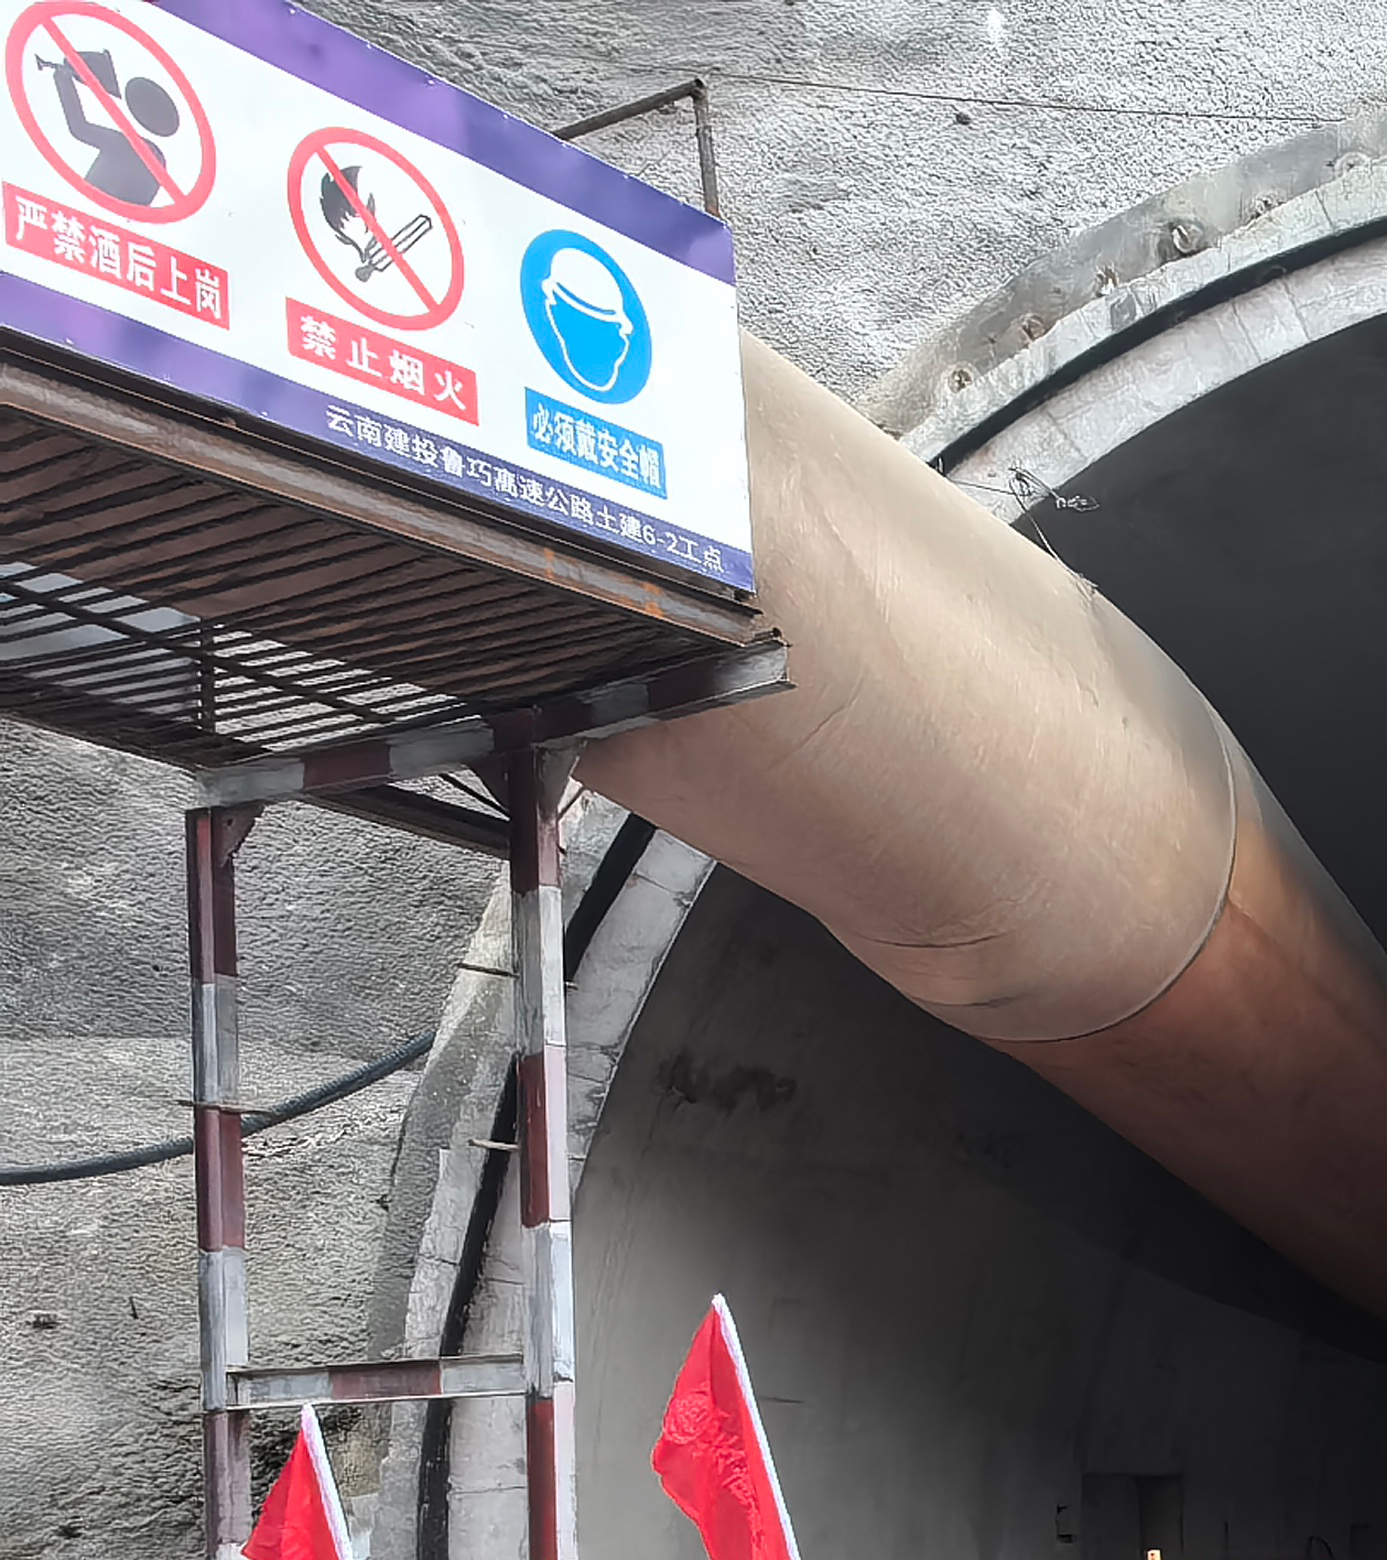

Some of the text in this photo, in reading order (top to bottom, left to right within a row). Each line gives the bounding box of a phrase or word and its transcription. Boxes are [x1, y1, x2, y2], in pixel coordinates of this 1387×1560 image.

[15, 195, 222, 319] 严禁酒后上岗
[300, 315, 467, 411] 禁止烟火
[533, 402, 662, 489] 必须戴安全帽
